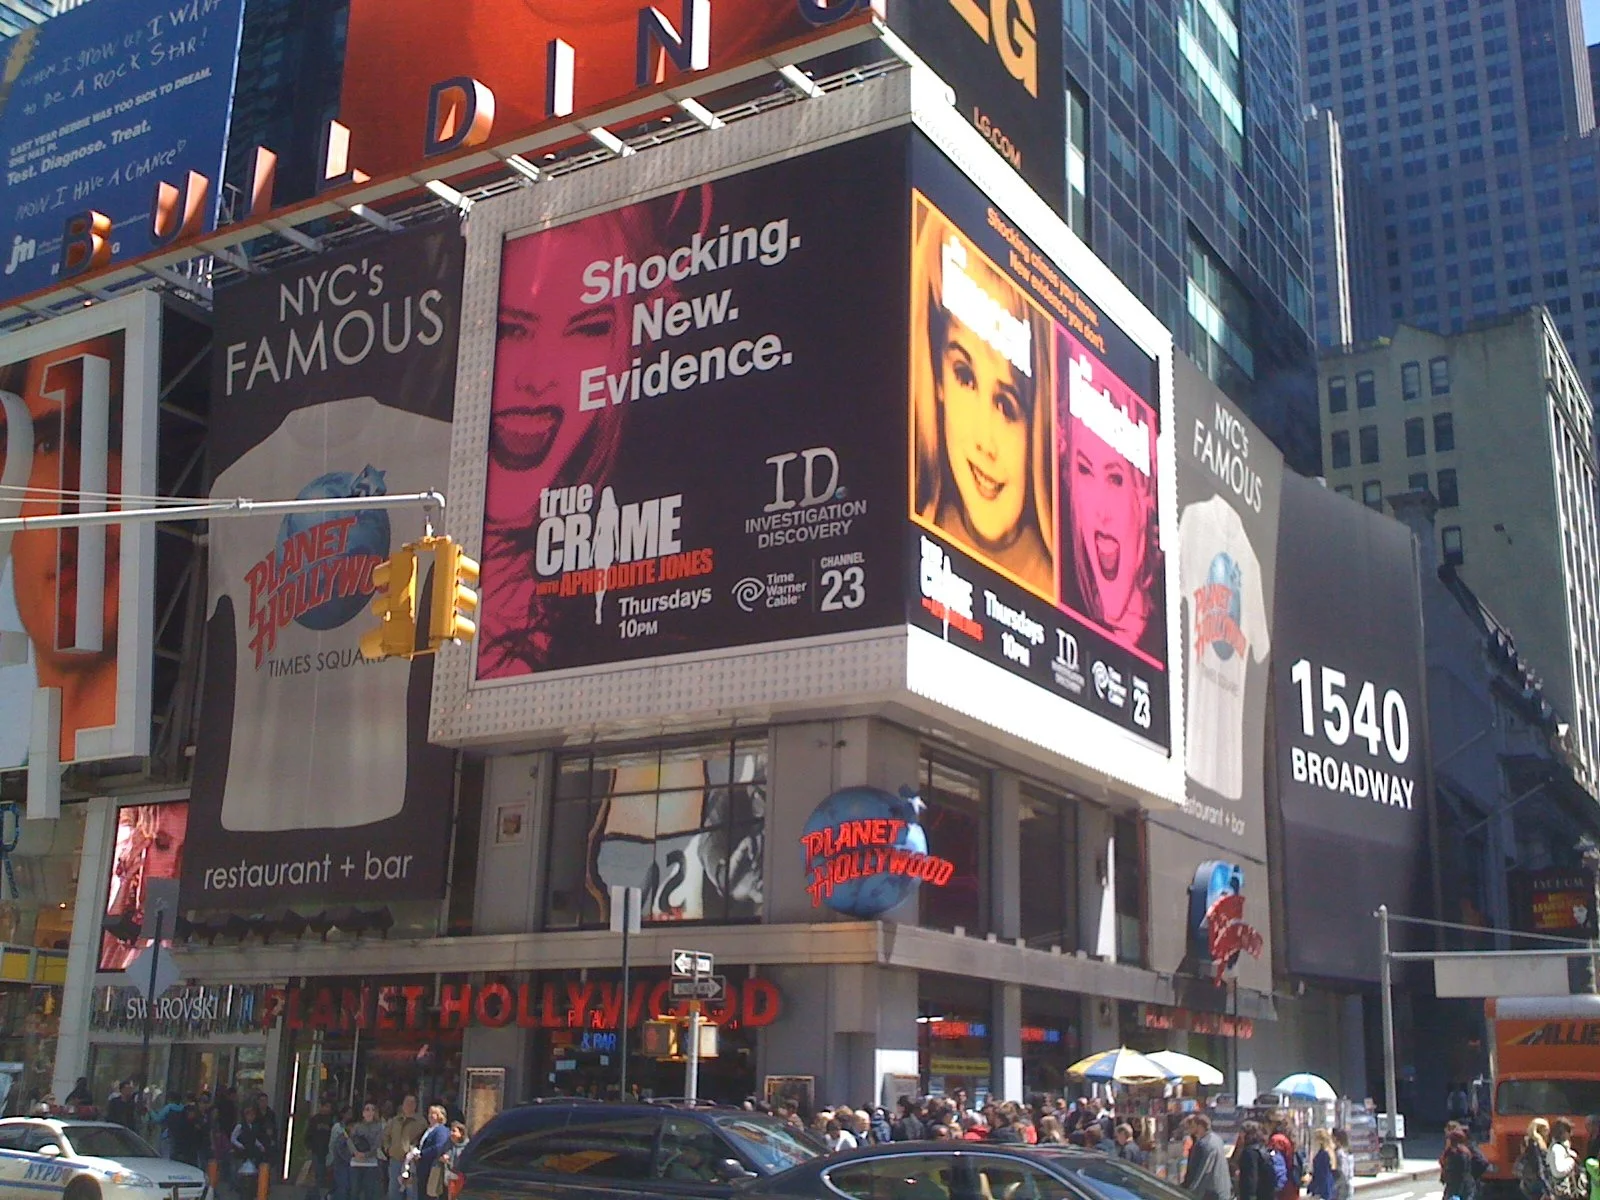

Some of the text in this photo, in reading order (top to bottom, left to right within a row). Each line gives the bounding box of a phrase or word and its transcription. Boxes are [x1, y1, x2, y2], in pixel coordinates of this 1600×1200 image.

[60, 57, 73, 74] I
[147, 15, 163, 42] I
[71, 80, 85, 97] A
[35, 130, 58, 146] YEAR
[92, 106, 113, 122] WAS
[114, 99, 134, 114] TOO
[135, 90, 157, 106] SICK
[159, 82, 173, 96] TO
[7, 119, 152, 187] Test. Diagnose. Treat.
[51, 185, 68, 210] I
[107, 168, 120, 187] A
[580, 217, 801, 305] Shocking.
[631, 288, 739, 347] New.
[226, 289, 444, 397] FAMOUS
[578, 333, 793, 412] Evidence.
[763, 447, 840, 512] ID
[1193, 419, 1264, 514] FAMOUS
[539, 483, 594, 519] true
[745, 500, 867, 534] INVESTIGATION
[758, 519, 853, 549] DISCOVERY
[244, 516, 358, 629] PLANET
[560, 558, 656, 597] APHRODITE
[658, 548, 713, 582] JONES
[766, 572, 795, 585] Time
[820, 551, 865, 569] CHANNEL
[249, 554, 389, 670] HOLLYWO
[618, 587, 712, 617] Thursdays
[766, 582, 807, 597] Warner
[766, 594, 798, 609] Cable
[820, 566, 866, 612] 23
[618, 618, 658, 639] 10PM
[984, 589, 1045, 645] Thursdays
[268, 656, 311, 678] TIMES
[1056, 628, 1078, 669] ID
[1291, 658, 1409, 765] 1540
[1291, 746, 1415, 811] BROADWAY
[204, 852, 332, 890] restaurant
[365, 850, 413, 880] bar
[800, 819, 906, 874] PLANET
[805, 848, 955, 908] HOLLYWOOD
[262, 985, 424, 1034] PLANET
[440, 977, 781, 1029] HOLLYWOOD
[593, 1032, 616, 1051] BAR
[24, 1163, 62, 1182] NYPD
